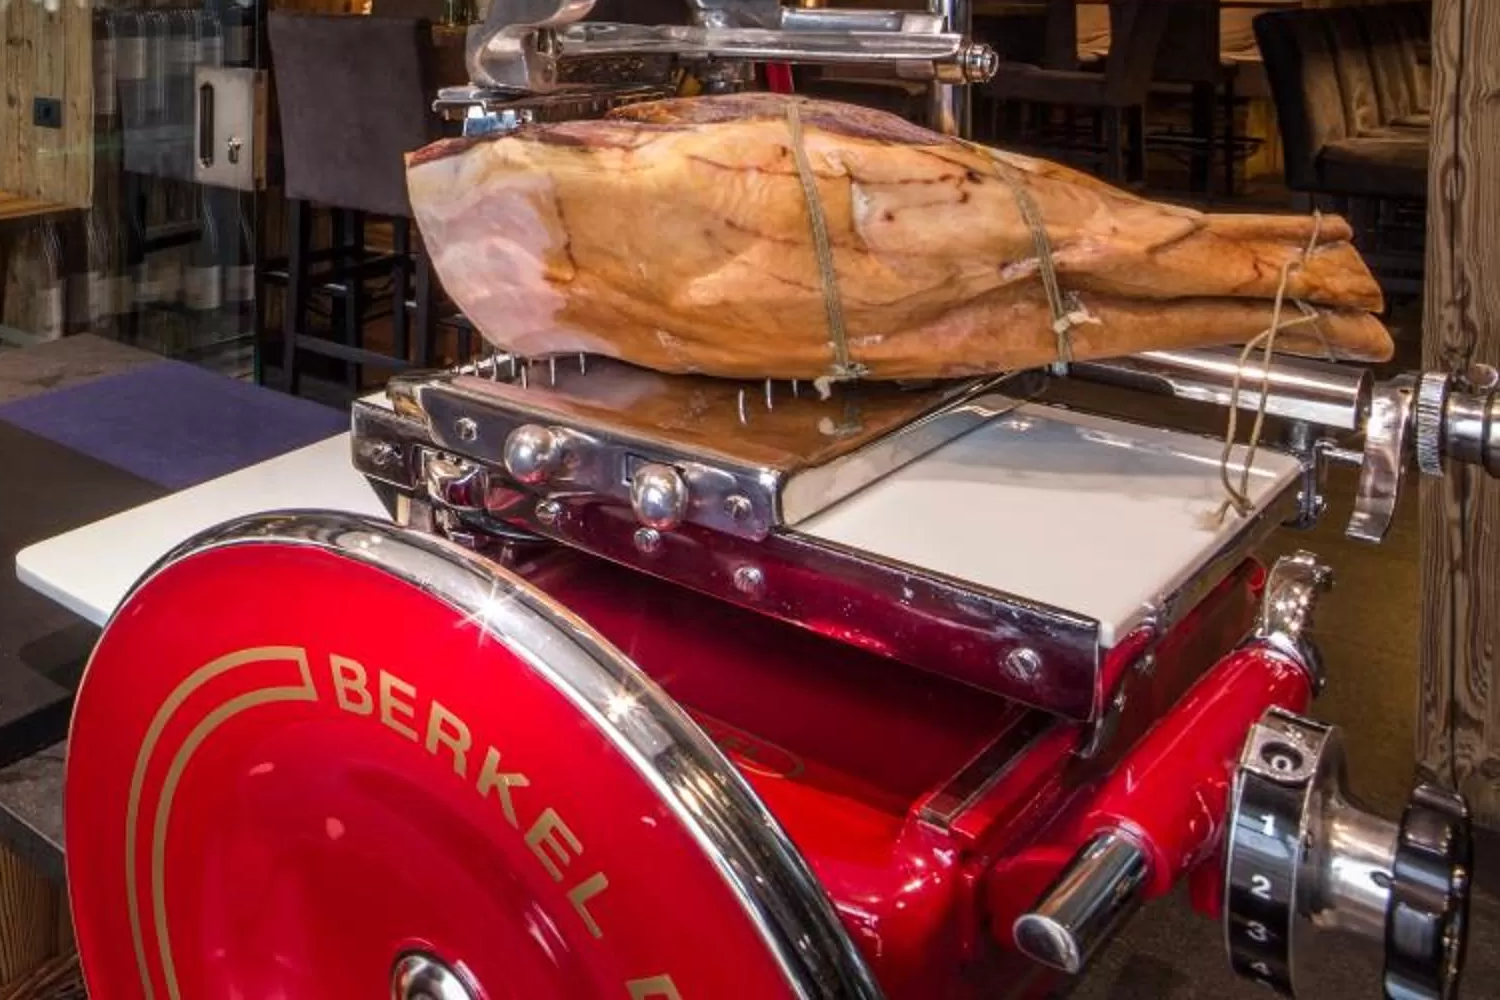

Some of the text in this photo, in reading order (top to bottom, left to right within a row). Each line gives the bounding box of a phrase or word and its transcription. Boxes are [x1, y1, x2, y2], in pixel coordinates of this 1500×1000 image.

[327, 651, 612, 940] BERKEL
[1259, 814, 1277, 836] 1
[1250, 874, 1273, 901] 2
[1246, 919, 1270, 942] 3
